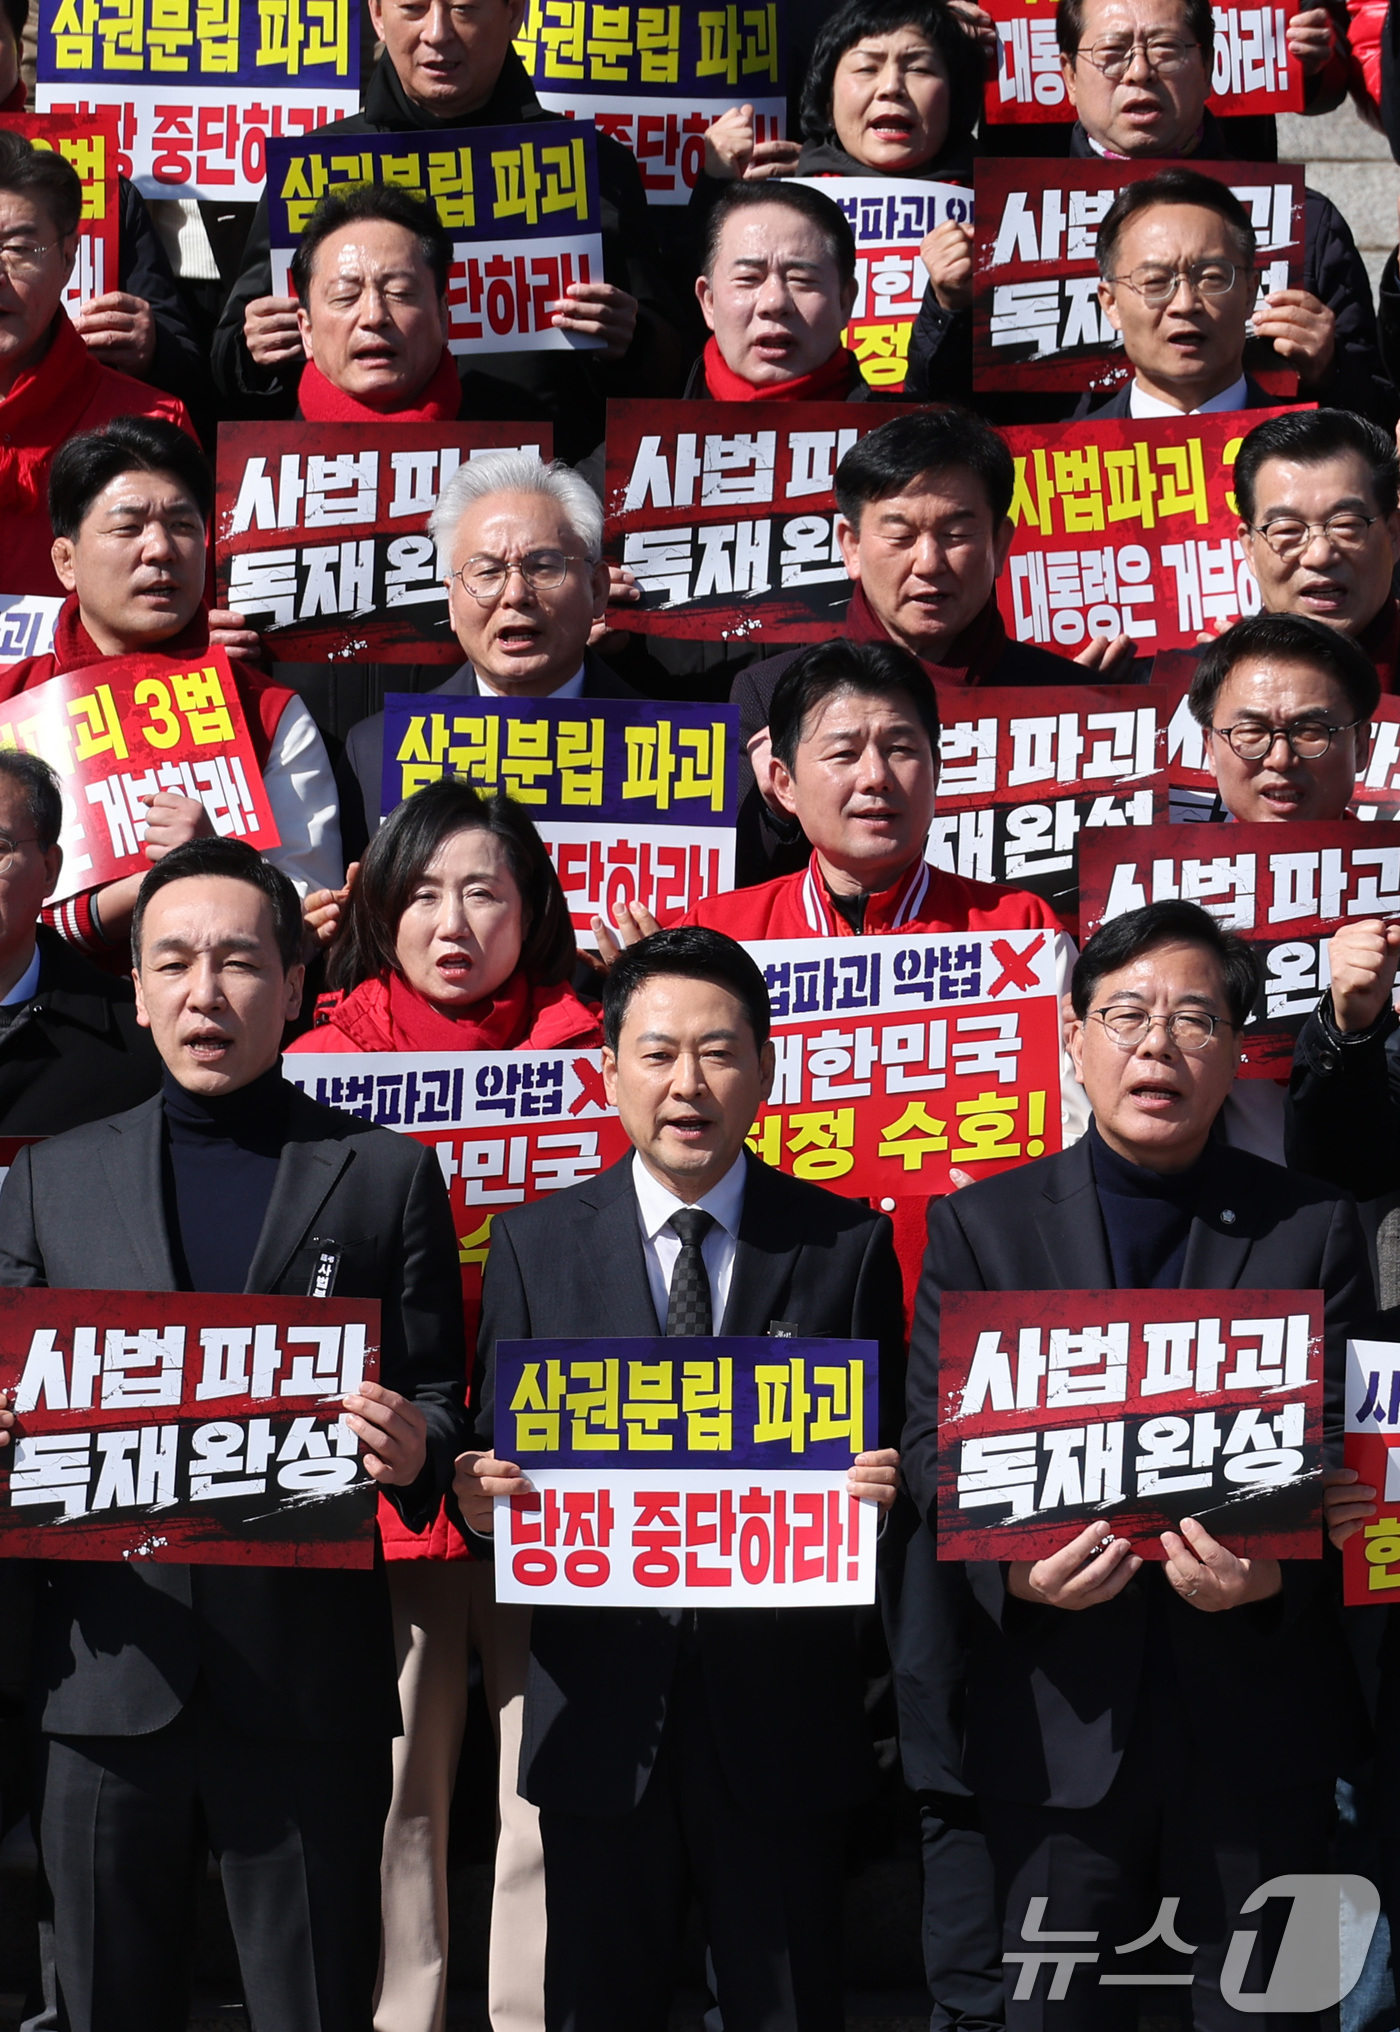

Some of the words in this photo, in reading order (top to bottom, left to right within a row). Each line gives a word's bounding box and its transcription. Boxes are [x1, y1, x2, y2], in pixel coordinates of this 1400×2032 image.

[50, 0, 239, 73] 삼권분립
[256, 0, 348, 76] 파괴
[696, 3, 778, 84] 파괴
[1211, 6, 1289, 96] 하라!
[491, 138, 588, 225] 파괴
[837, 196, 936, 241] 파괴
[1228, 184, 1293, 247] 괴
[448, 253, 590, 340] 단하라
[840, 322, 914, 386] 정
[231, 451, 379, 531] 사법
[389, 445, 540, 519] 파
[622, 431, 777, 509] 사법
[785, 428, 858, 499] 파
[1008, 438, 1209, 536] 사법파괴
[228, 539, 376, 625] 독재
[385, 535, 449, 608] 완
[620, 519, 773, 605] 독재
[780, 513, 850, 589] 완
[1009, 544, 1157, 645] 대통령은
[134, 666, 236, 749] 3법
[396, 713, 605, 806] 삼권분립
[622, 720, 726, 812] 파괴
[936, 717, 998, 797] 법
[1008, 707, 1158, 787] 파괴
[545, 838, 720, 931] 단하라!
[923, 809, 996, 884] 재
[1099, 853, 1257, 931] 사법
[762, 952, 881, 1018] 법파괴
[892, 942, 982, 1002] 악법
[1264, 936, 1334, 1020] 완
[475, 1060, 564, 1119] 악법
[878, 1089, 1047, 1172] 수호!
[436, 1131, 602, 1206] 민국
[13, 1325, 187, 1412] 사법
[195, 1323, 367, 1402] 파괴
[508, 1357, 733, 1452] 삼권분립
[753, 1358, 864, 1453] 파괴
[958, 1321, 1130, 1413] 사법
[1140, 1313, 1311, 1398] 파괴
[9, 1424, 180, 1519] 독재
[188, 1412, 361, 1502] 완성
[957, 1420, 1127, 1518] 독재
[1135, 1402, 1306, 1499] 완성
[509, 1488, 615, 1588] 당장
[631, 1486, 860, 1588] 중단하라!
